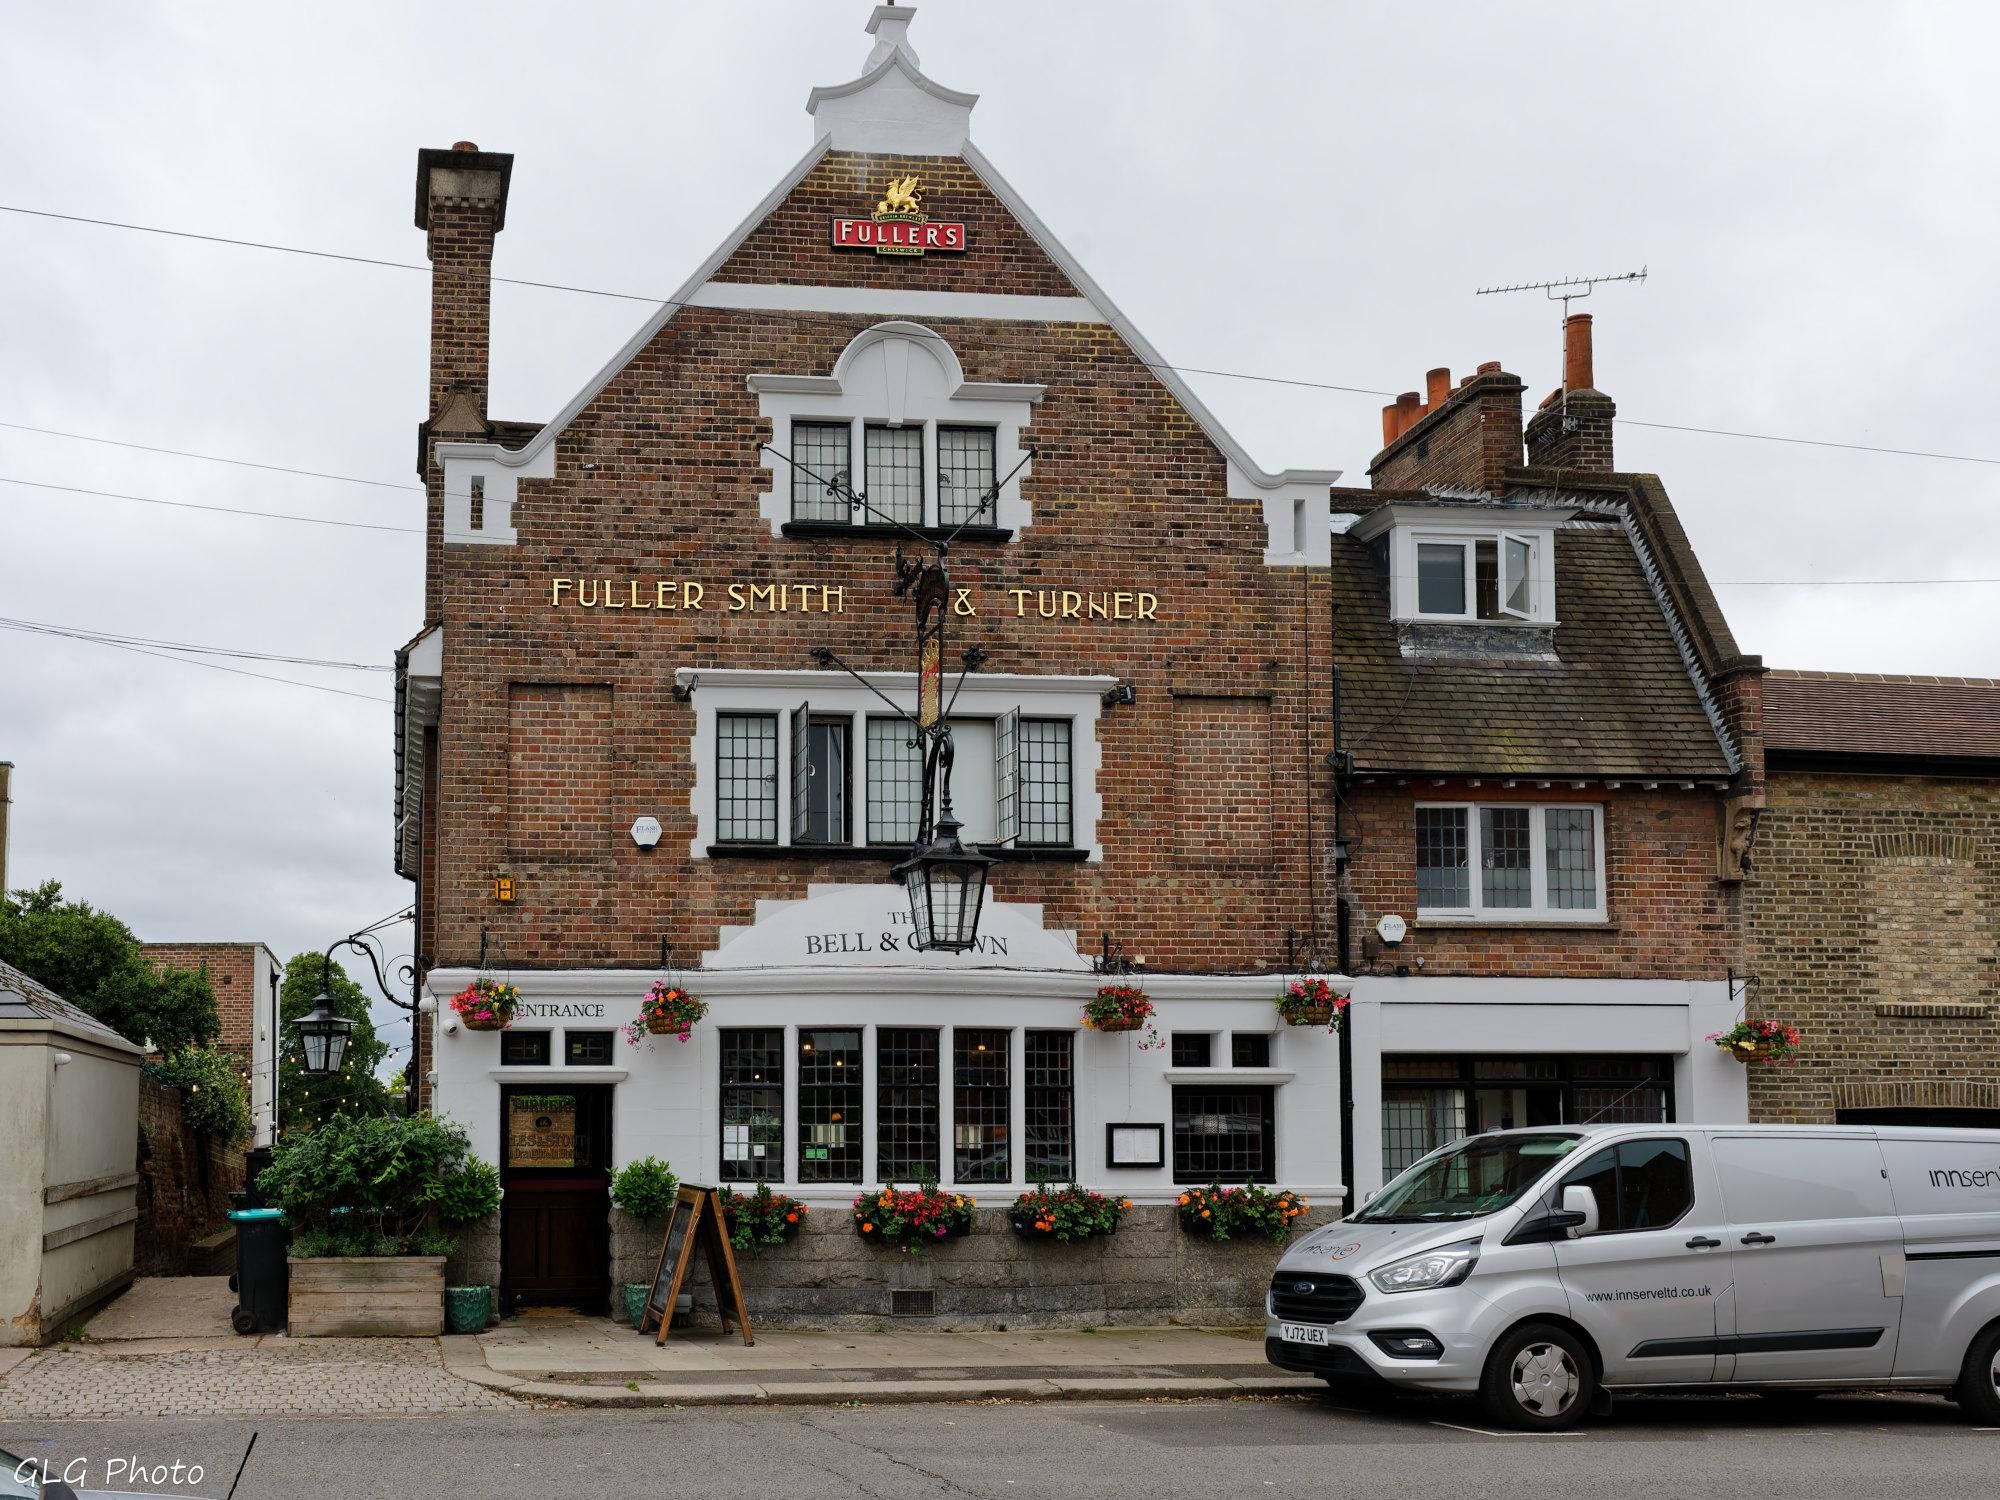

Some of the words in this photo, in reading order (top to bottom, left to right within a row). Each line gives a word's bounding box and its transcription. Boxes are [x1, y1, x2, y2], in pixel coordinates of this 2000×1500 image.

[841, 221, 957, 247] FULLER'S
[551, 577, 705, 610] FULLER
[727, 582, 845, 614] SMITH
[953, 588, 976, 616] &
[1008, 588, 1158, 621] TURNER
[636, 825, 658, 833] FLASH
[805, 932, 872, 954] BELL
[880, 931, 899, 952] &
[515, 1004, 604, 1017] ENTRANCE
[1585, 1285, 1712, 1302] www.innserveltd.co.uk
[1284, 1326, 1305, 1341] YJ72
[1307, 1328, 1325, 1343] UEX
